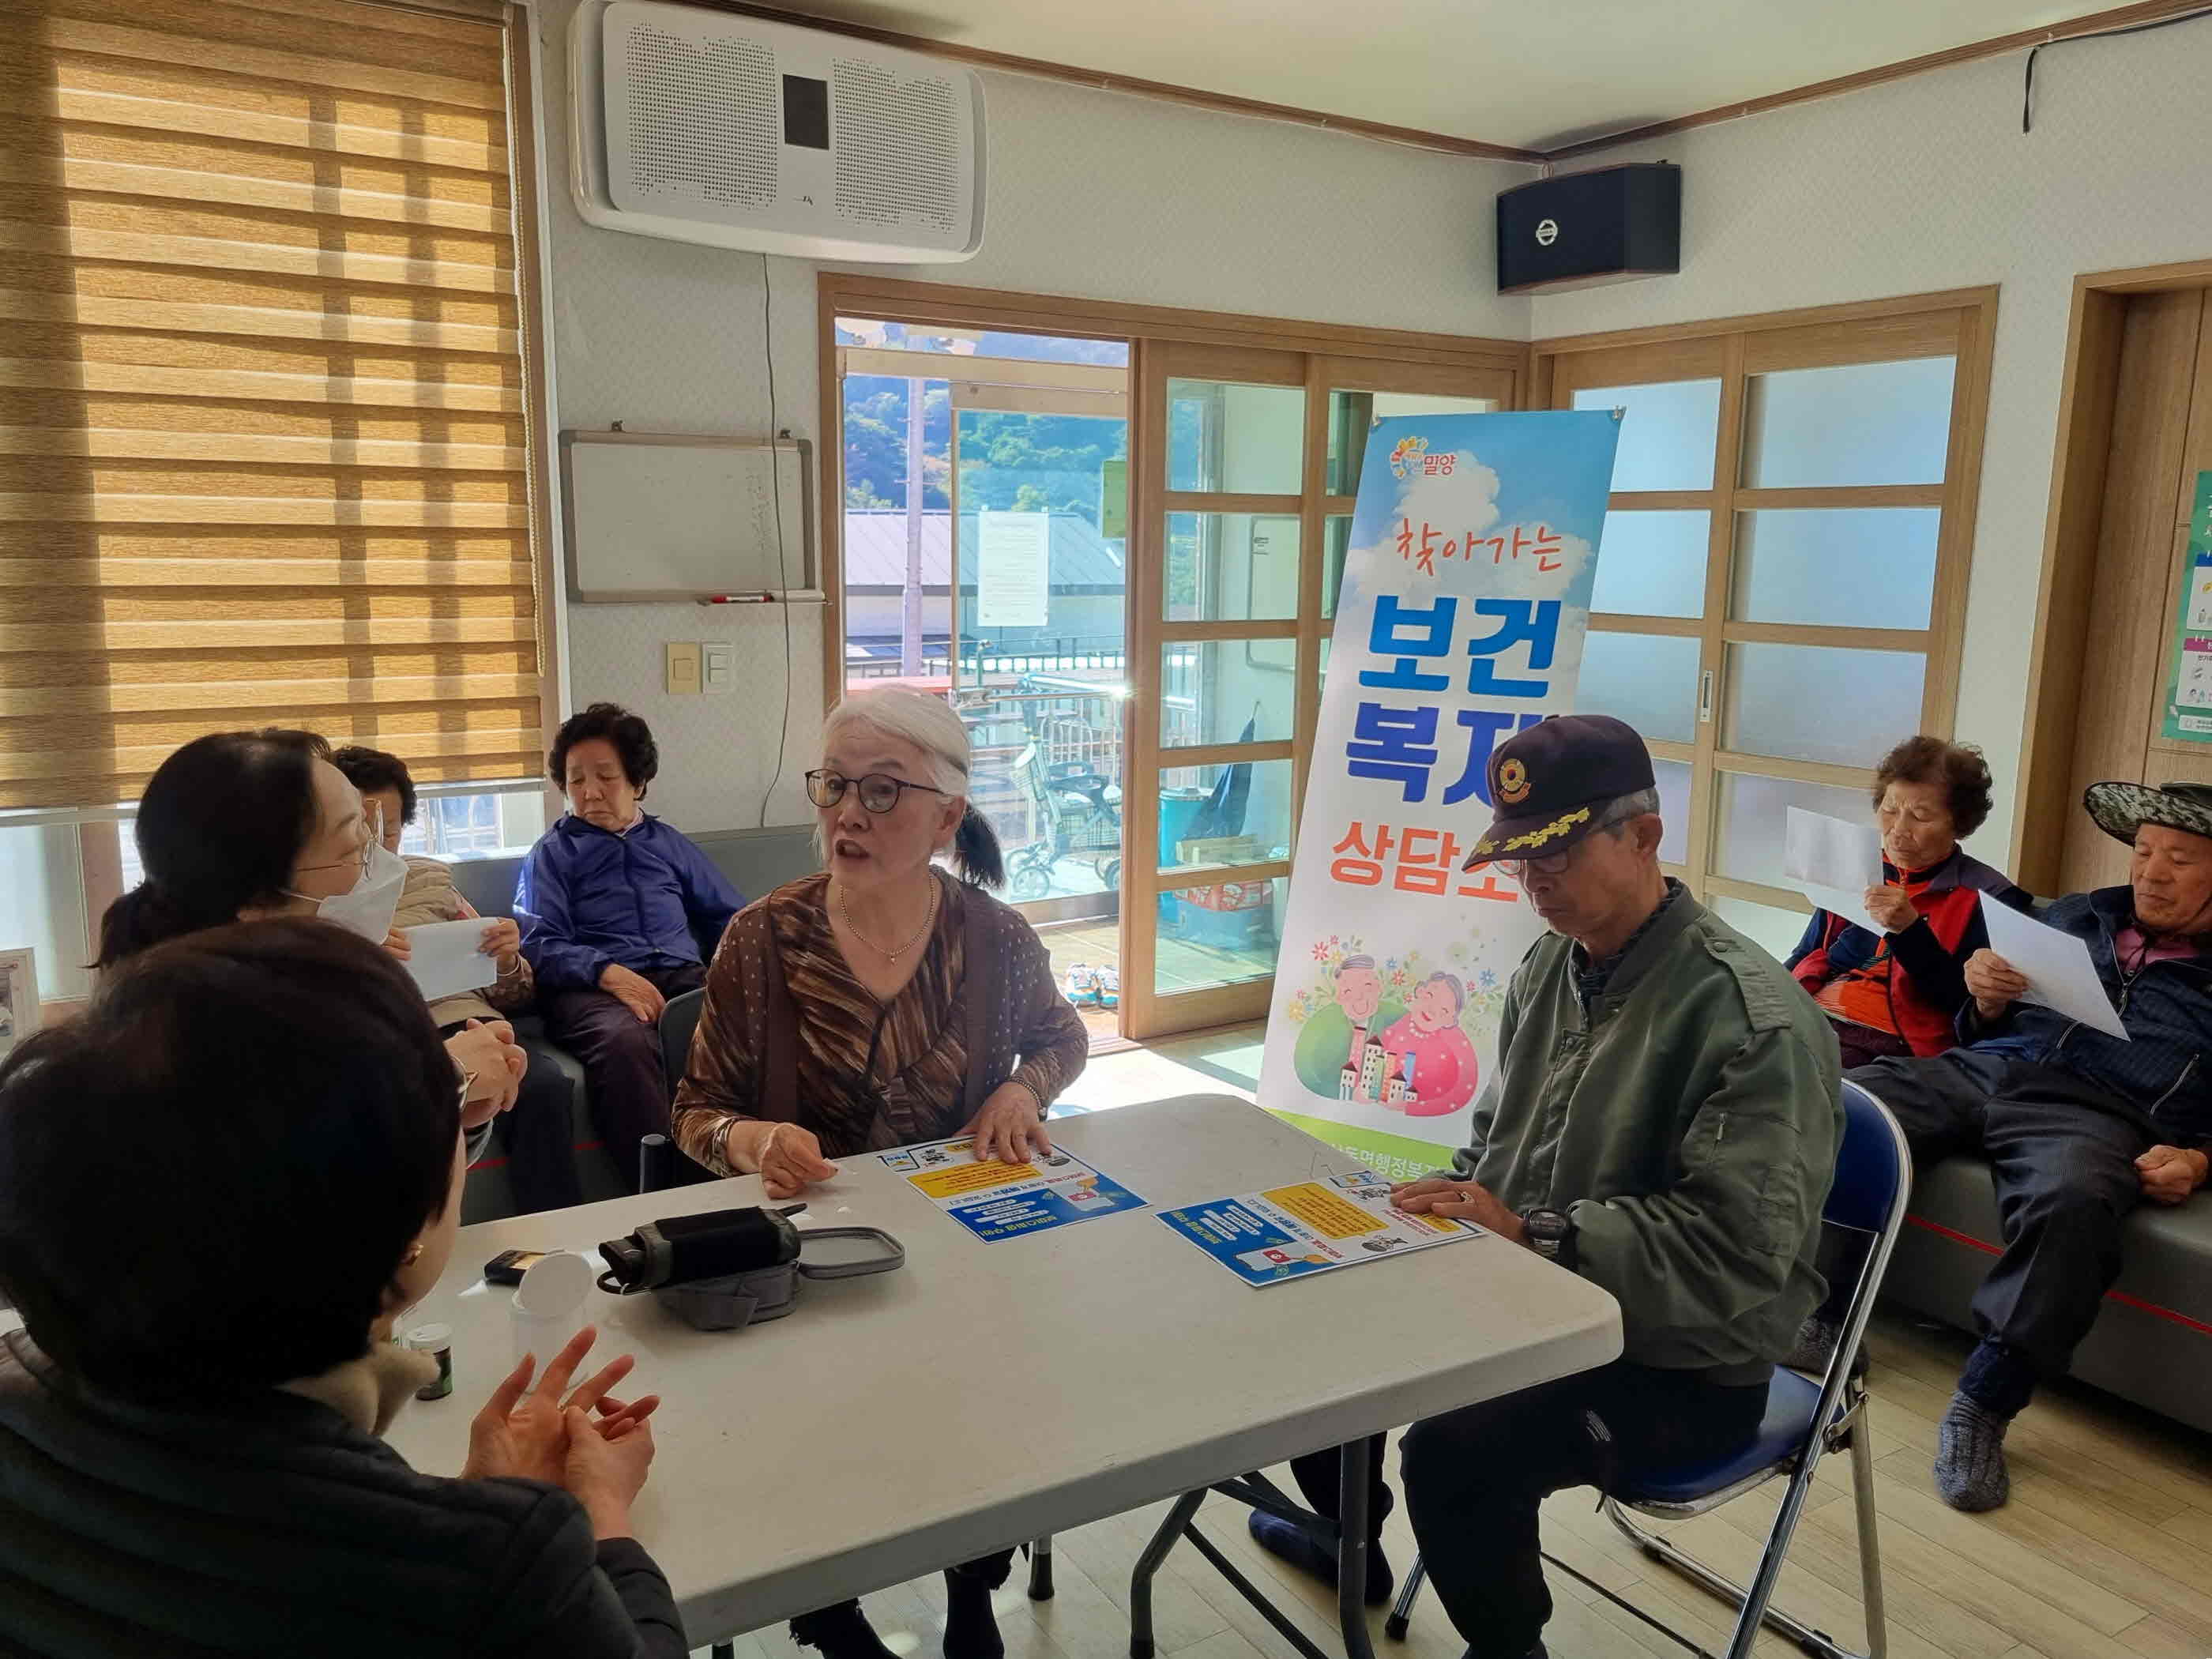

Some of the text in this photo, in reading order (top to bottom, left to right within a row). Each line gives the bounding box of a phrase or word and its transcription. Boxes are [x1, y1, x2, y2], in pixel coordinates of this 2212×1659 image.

[1424, 454, 1457, 476] 밀양
[1396, 518, 1562, 577] 찾아가는
[1358, 595, 1562, 698] 보건
